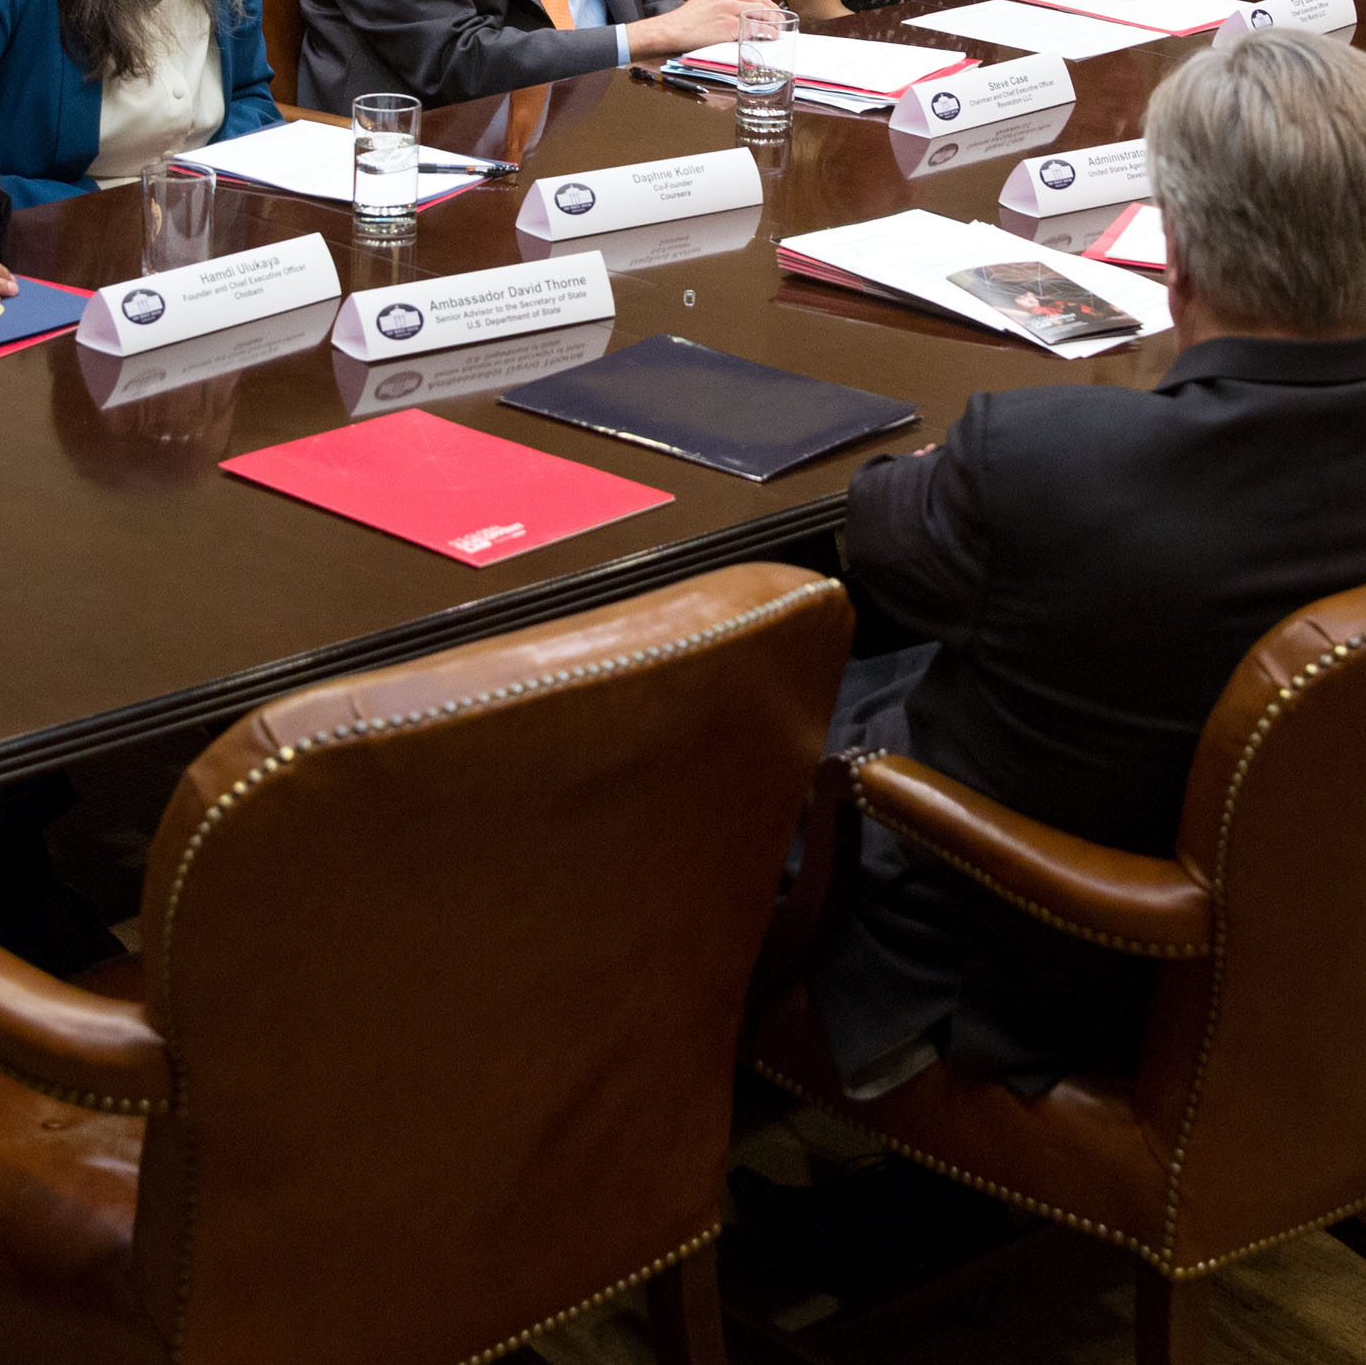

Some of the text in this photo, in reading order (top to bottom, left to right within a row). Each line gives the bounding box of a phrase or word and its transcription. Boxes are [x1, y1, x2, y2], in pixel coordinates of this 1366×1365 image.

[988, 75, 1028, 91] Steve Case
[632, 164, 705, 184] Daphne Koller
[660, 190, 691, 201] Coursera
[182, 264, 306, 302] Founder and Chief Executive Officer
[200, 257, 280, 284] Hamdi Ulukaya
[430, 276, 587, 311] Ambassador David Thorne
[435, 290, 587, 323] Senior Advisor to the Secretary of State
[467, 306, 561, 330] U.S. Department of State
